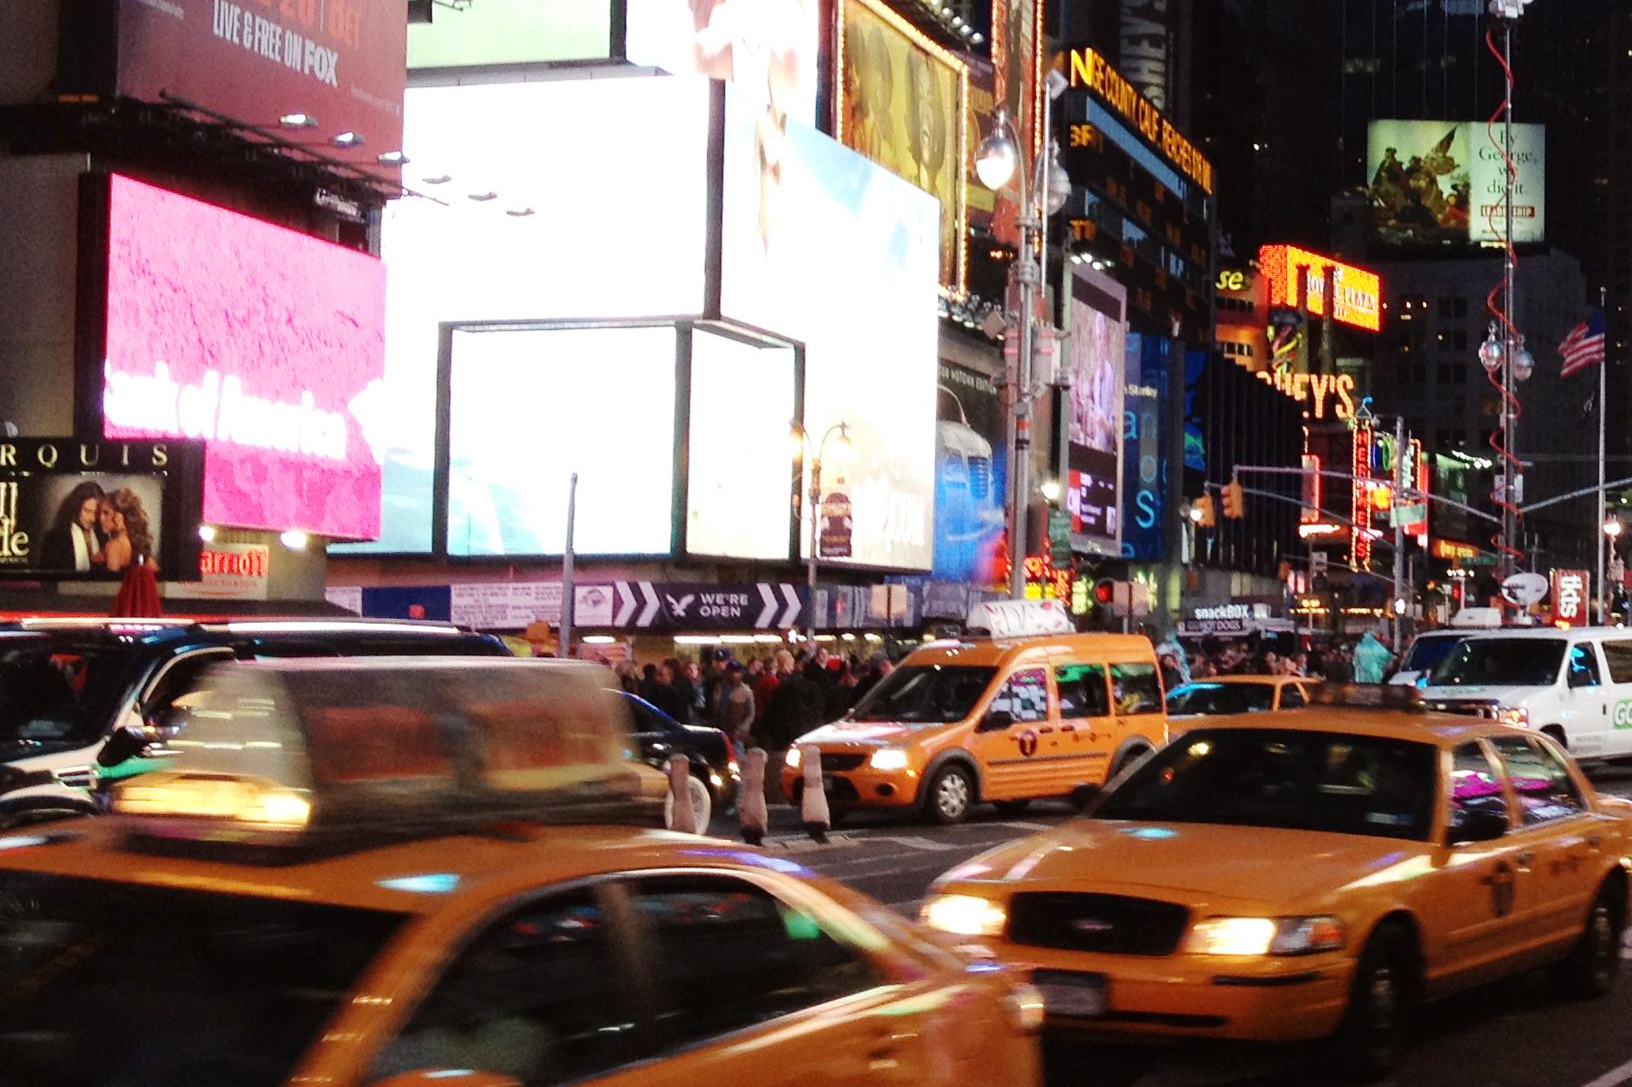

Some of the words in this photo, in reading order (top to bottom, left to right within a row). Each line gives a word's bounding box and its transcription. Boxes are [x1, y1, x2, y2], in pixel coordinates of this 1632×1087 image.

[253, 14, 282, 62] FREE
[283, 26, 303, 73] ON
[302, 32, 339, 88] FOX
[699, 593, 749, 607] WE'RE
[1558, 574, 1577, 620] tkts
[700, 605, 741, 618] OPEN
[1193, 603, 1250, 620] snackBOX
